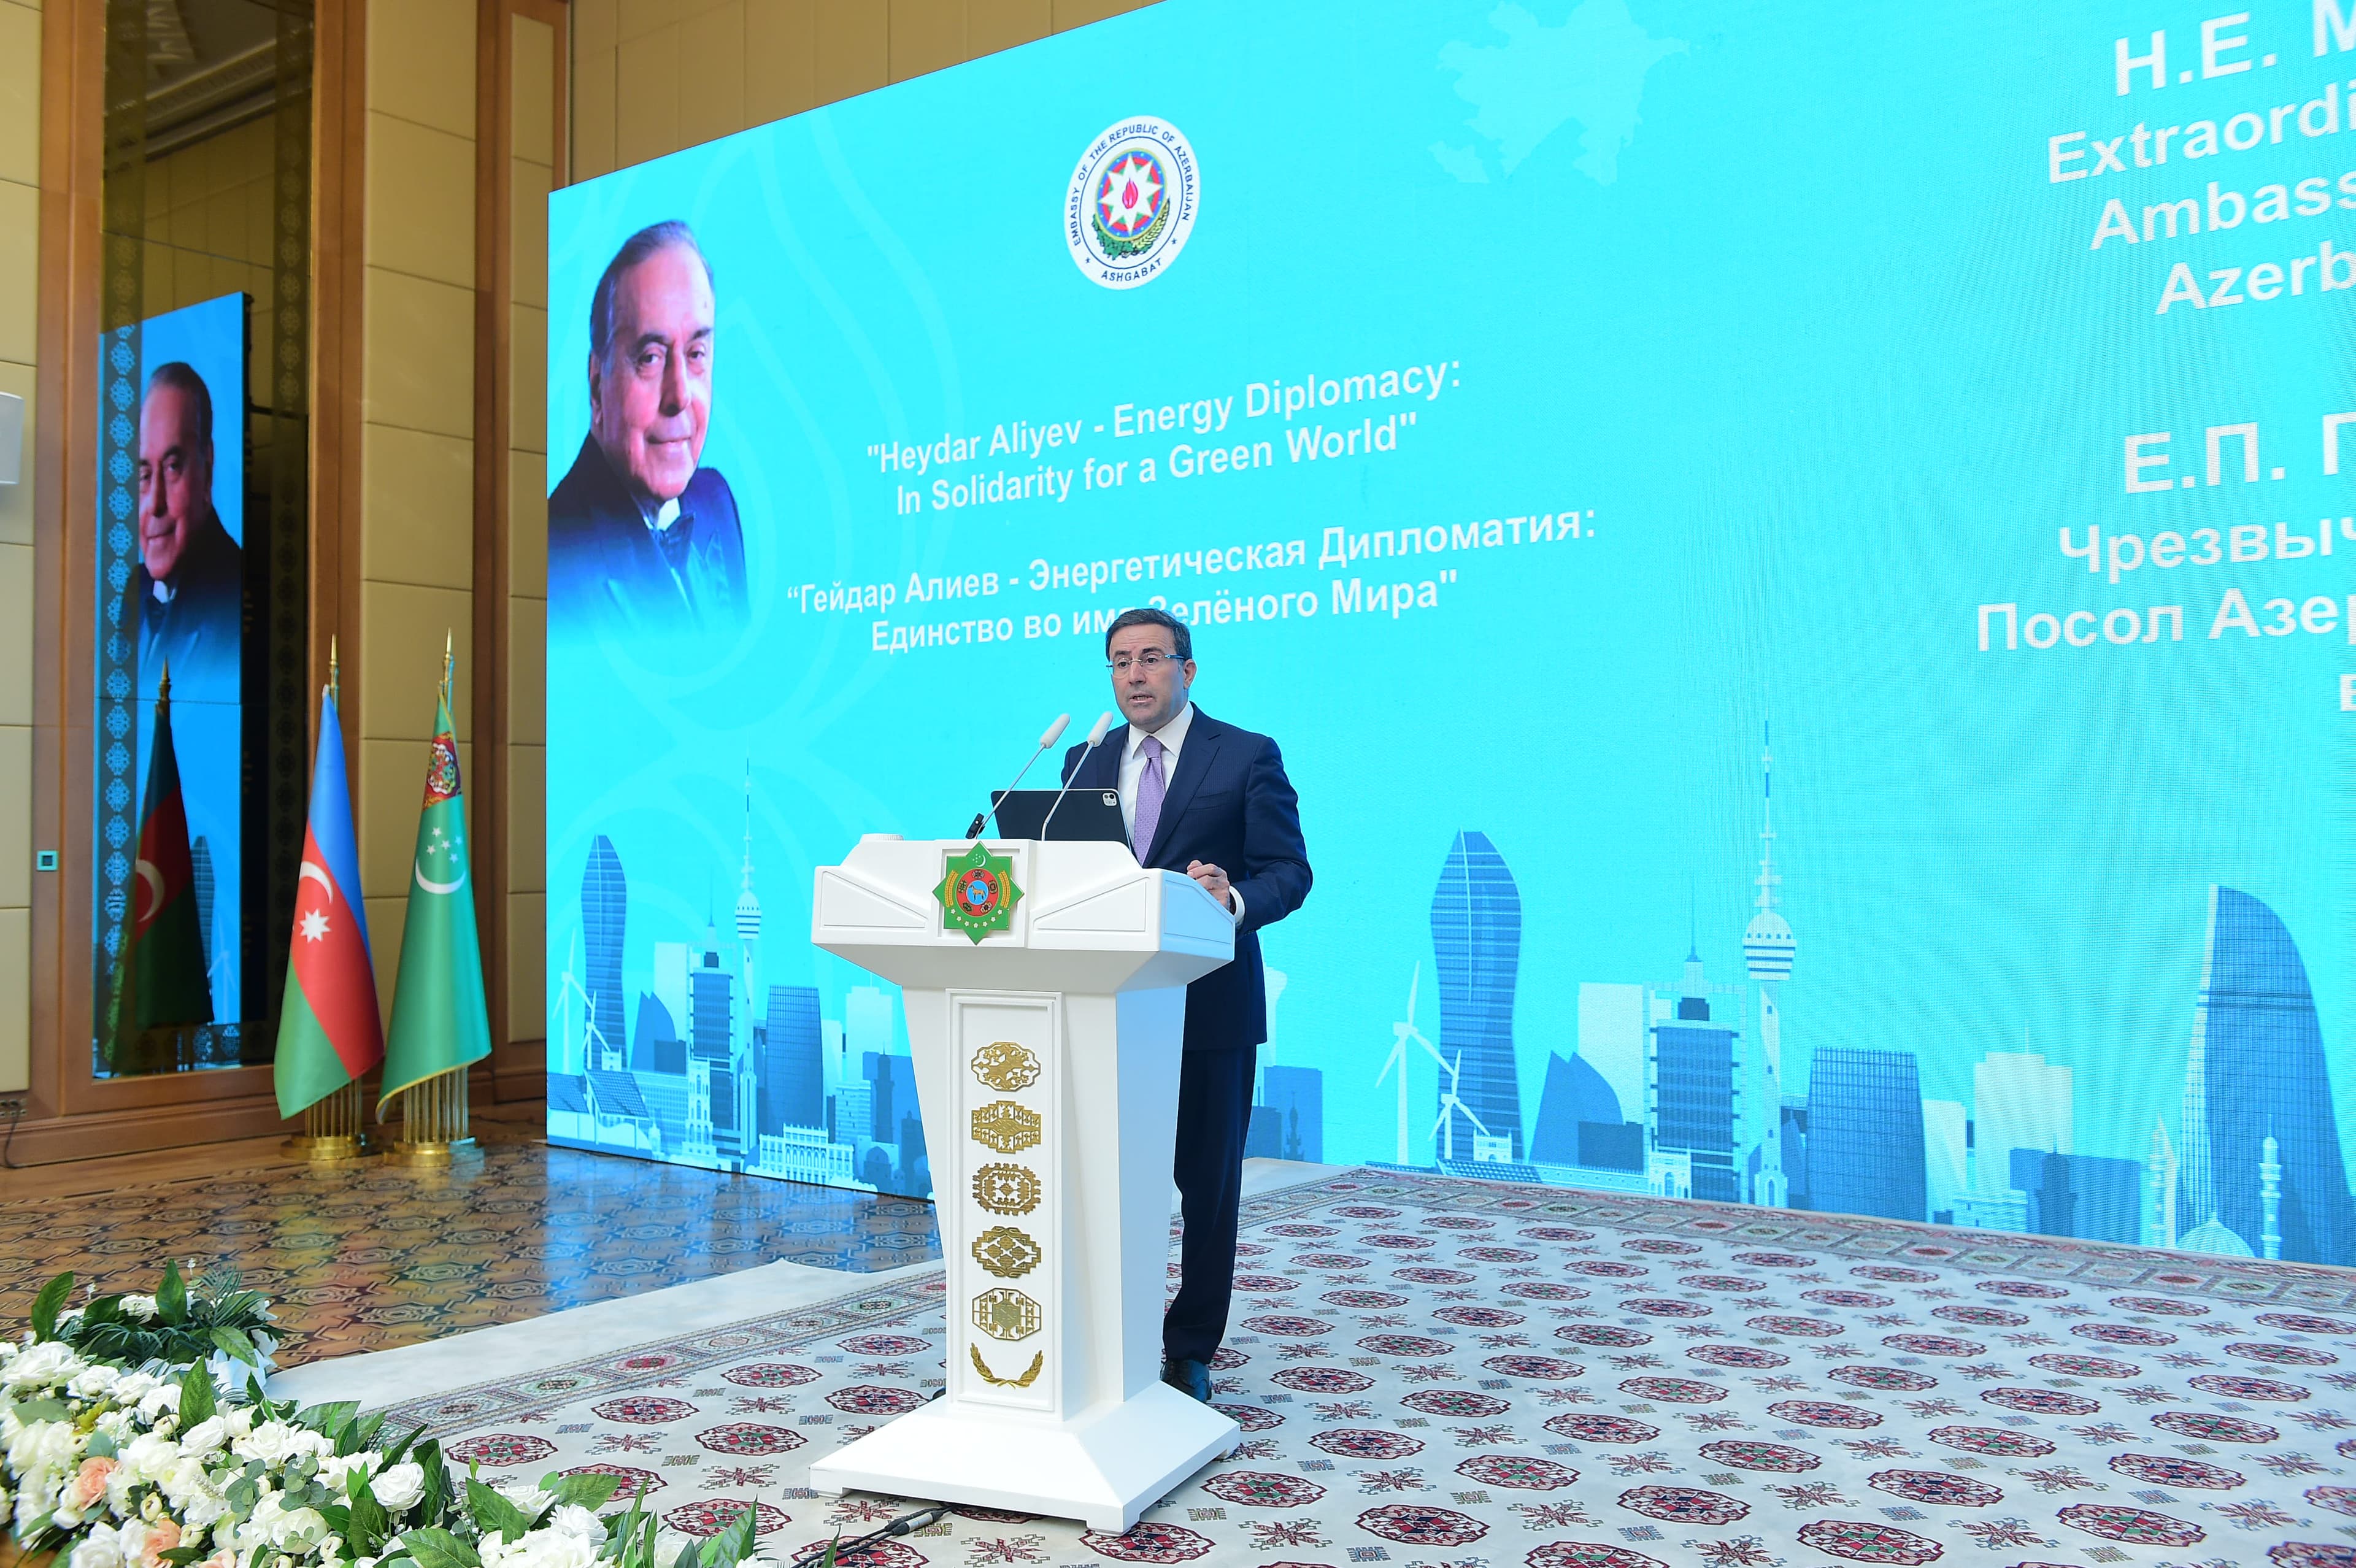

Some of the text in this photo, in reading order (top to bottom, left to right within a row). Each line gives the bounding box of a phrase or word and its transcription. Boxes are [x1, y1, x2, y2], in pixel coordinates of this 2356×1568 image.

[2115, 13, 2276, 96] H.E.
[2048, 80, 2356, 184] Extraordi
[1069, 123, 1194, 247] EMBASSY OF THE REPUBLIC OF AZERBAIJAN
[1101, 258, 1163, 282] ASHGABAT
[2156, 240, 2356, 314] Azerb
[868, 434, 980, 475] "Heydar
[989, 420, 1082, 458] Aliyev
[1115, 396, 1233, 437] Energy
[1246, 361, 1460, 421] Diplomacy:
[2125, 422, 2284, 493] Е.П.
[898, 412, 1417, 514] In Solidarity for a Green World"
[905, 573, 998, 602] Алиев
[1030, 540, 1304, 593] Энергетическая
[1319, 510, 1594, 570] Дипломатия:
[873, 618, 1013, 654] Единство
[1025, 614, 1061, 638] во
[1333, 569, 1457, 618] Мира"
[1978, 588, 2356, 651] Посол Азе
